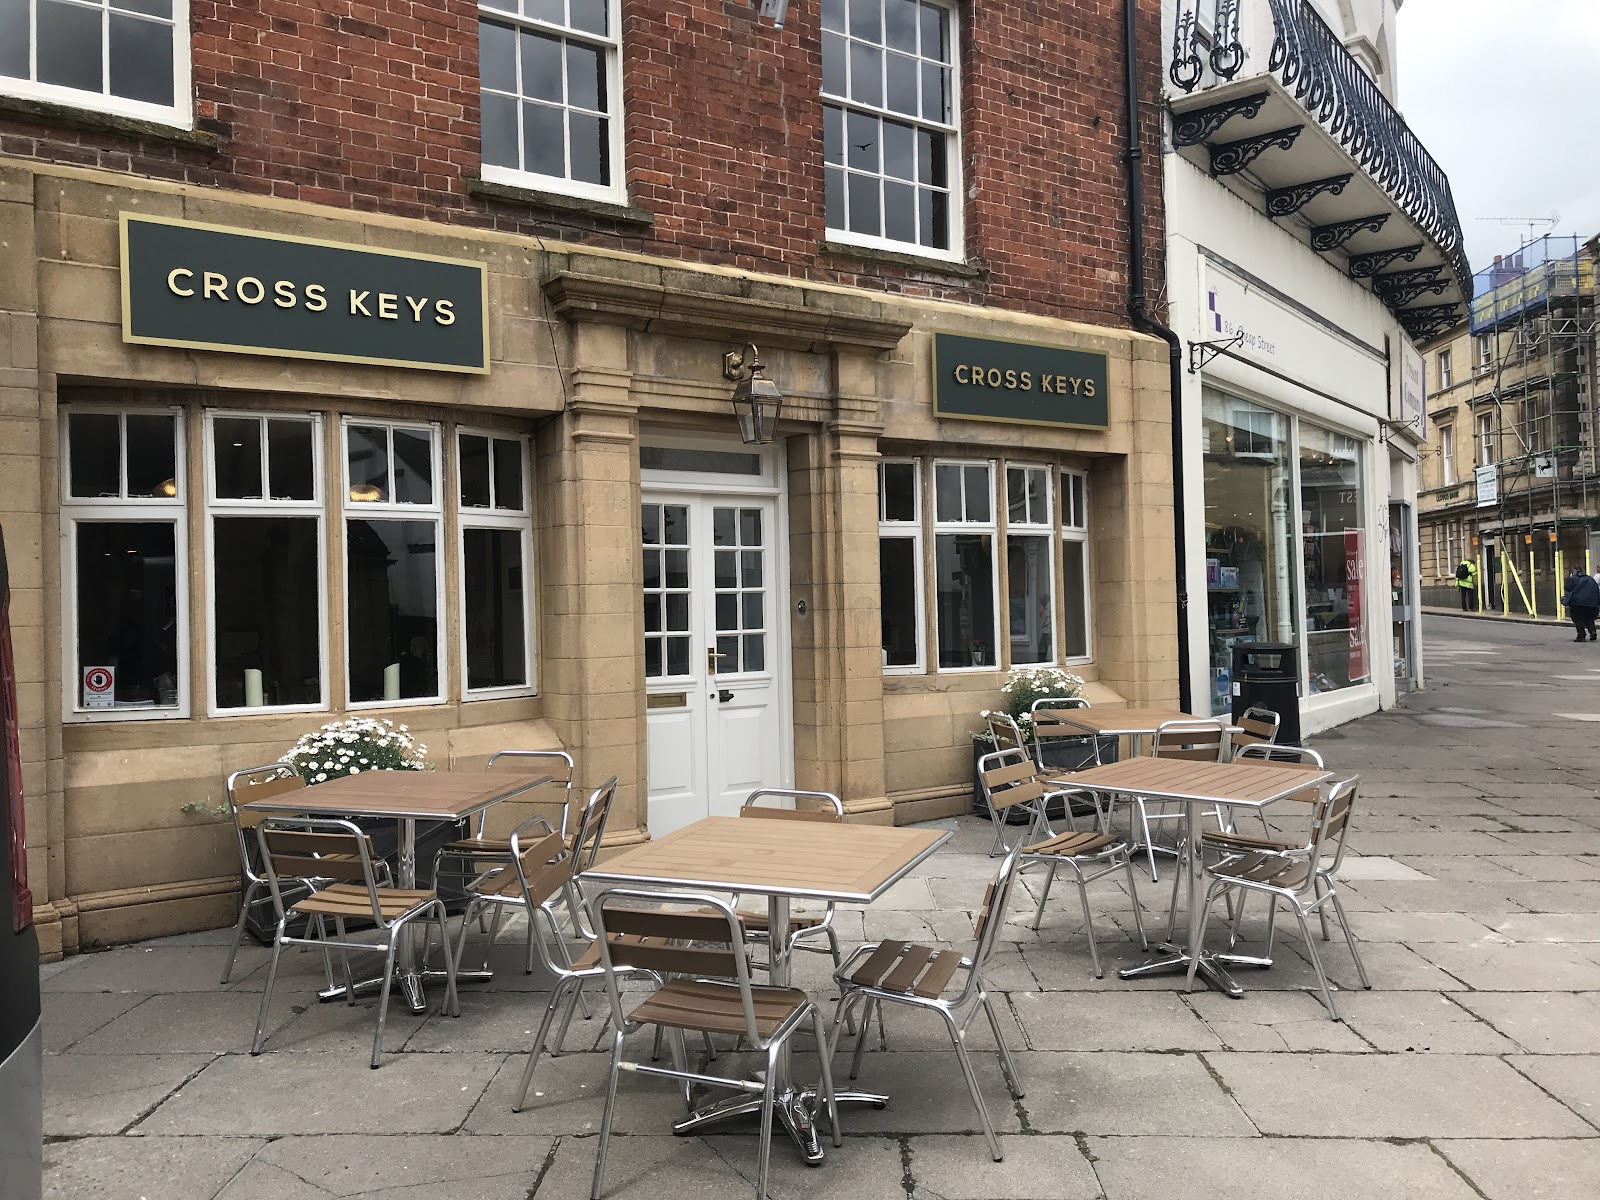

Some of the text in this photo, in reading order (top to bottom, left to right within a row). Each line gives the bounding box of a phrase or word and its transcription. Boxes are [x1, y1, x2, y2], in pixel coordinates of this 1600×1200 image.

[166, 267, 456, 326] CROSS KEYS
[954, 364, 1096, 397] CROSS KEYS
[1346, 551, 1364, 580] sale
